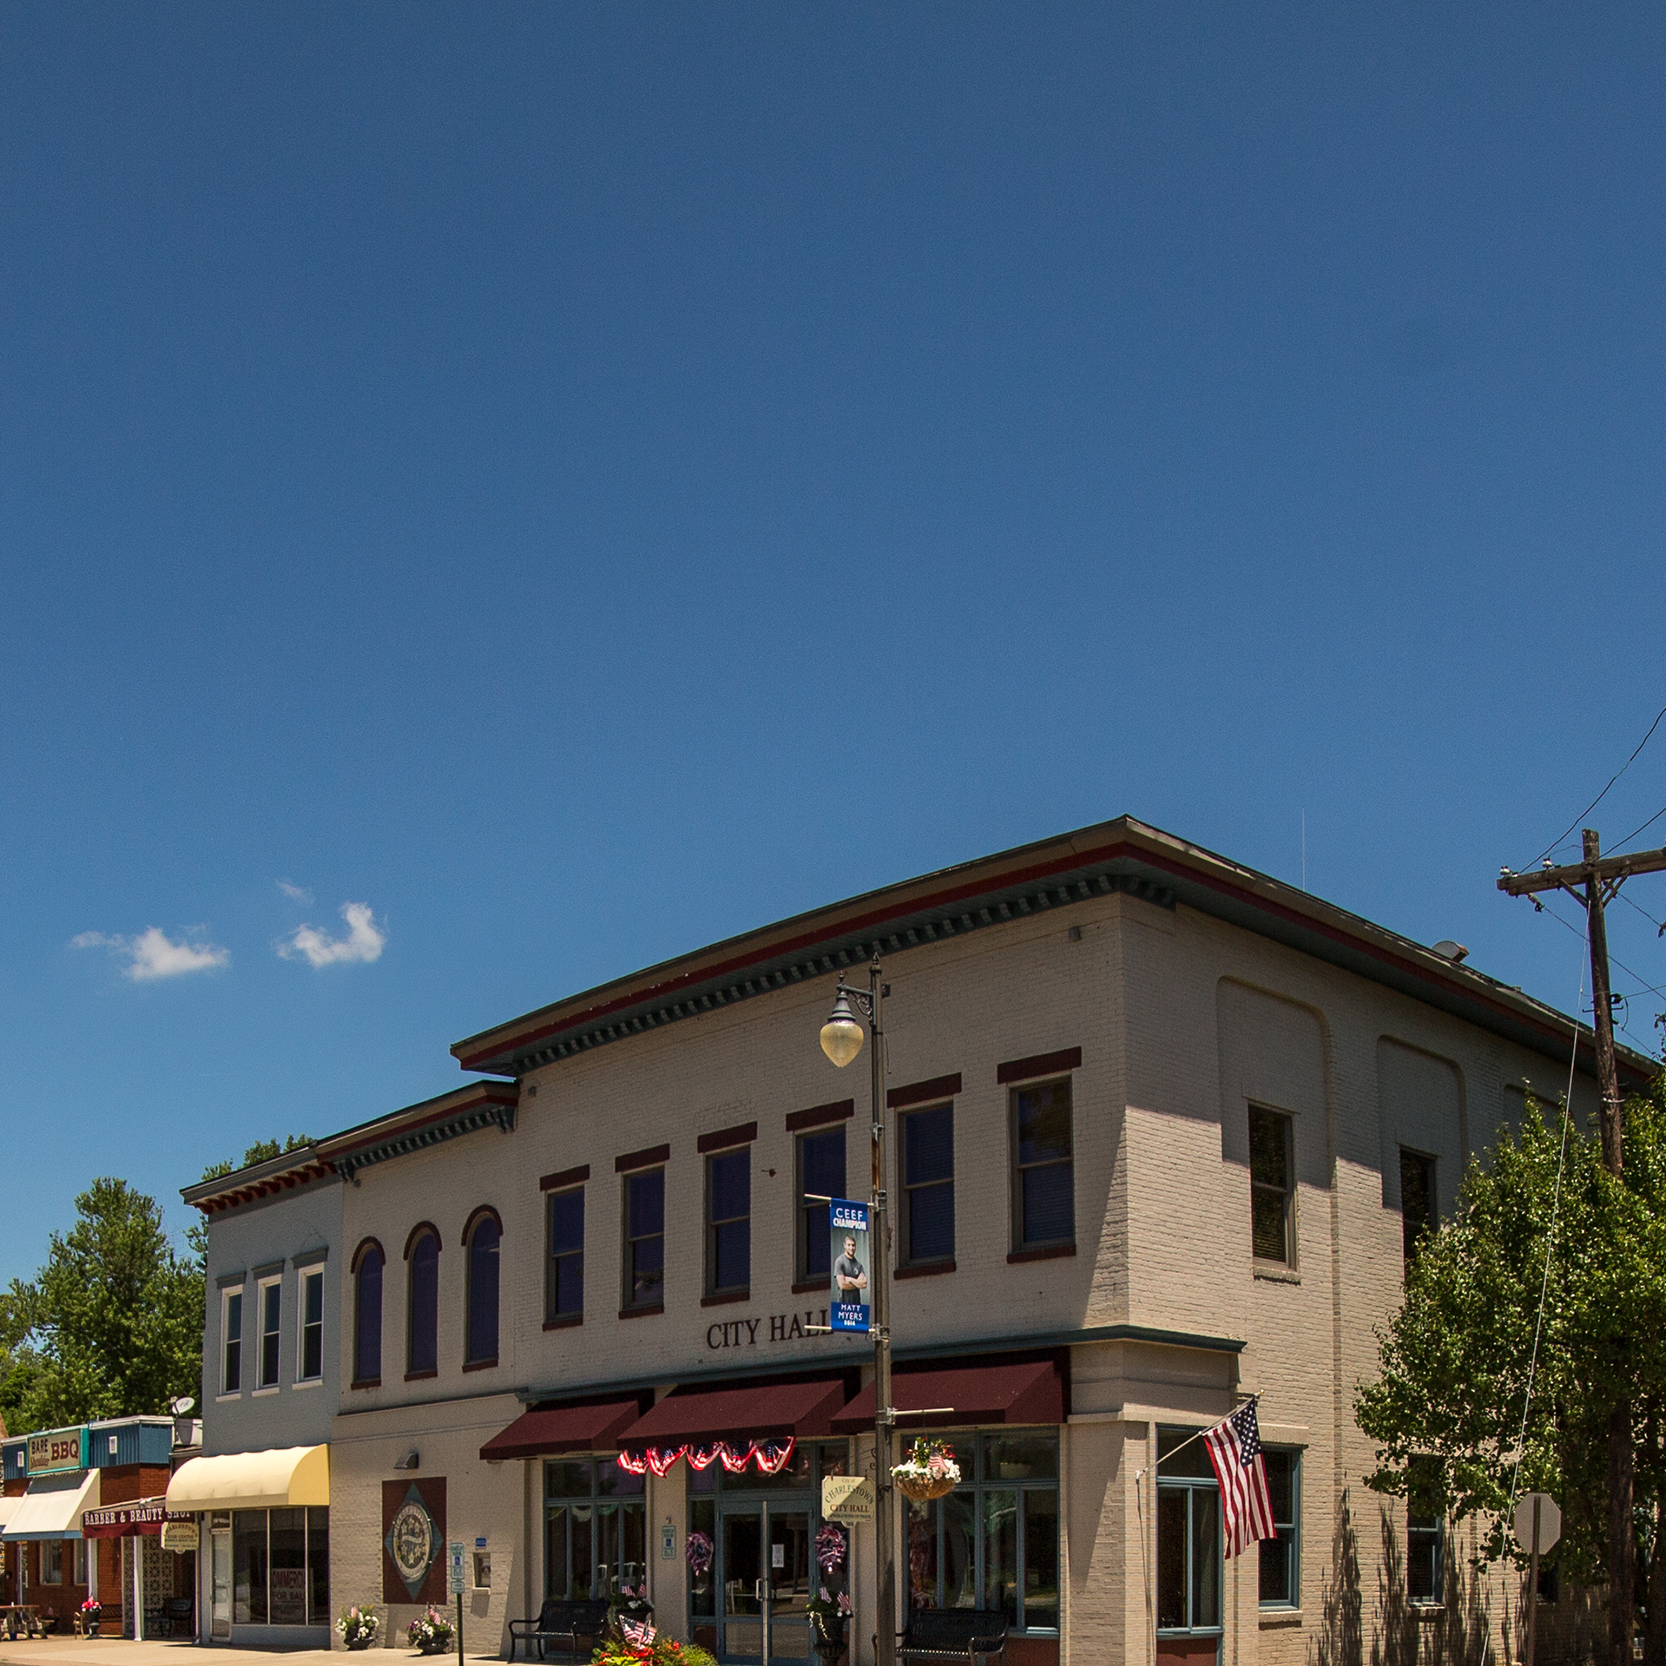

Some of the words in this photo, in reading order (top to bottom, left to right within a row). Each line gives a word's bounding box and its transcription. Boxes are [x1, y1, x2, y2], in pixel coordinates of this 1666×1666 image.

[835, 1207, 863, 1220] CEEF
[833, 1217, 867, 1231] CHAMPION
[840, 1304, 861, 1312] MATT
[838, 1311, 863, 1321] MYERS
[706, 1318, 761, 1349] CITY
[769, 1309, 834, 1342] HALL
[32, 1439, 48, 1454] BARE
[51, 1439, 79, 1461] BBQ
[825, 1485, 874, 1504] CHARLESTOWN
[830, 1504, 847, 1512] CITY
[85, 1512, 116, 1525] BARBER
[120, 1511, 125, 1523] &
[130, 1508, 163, 1522] BEAUTY
